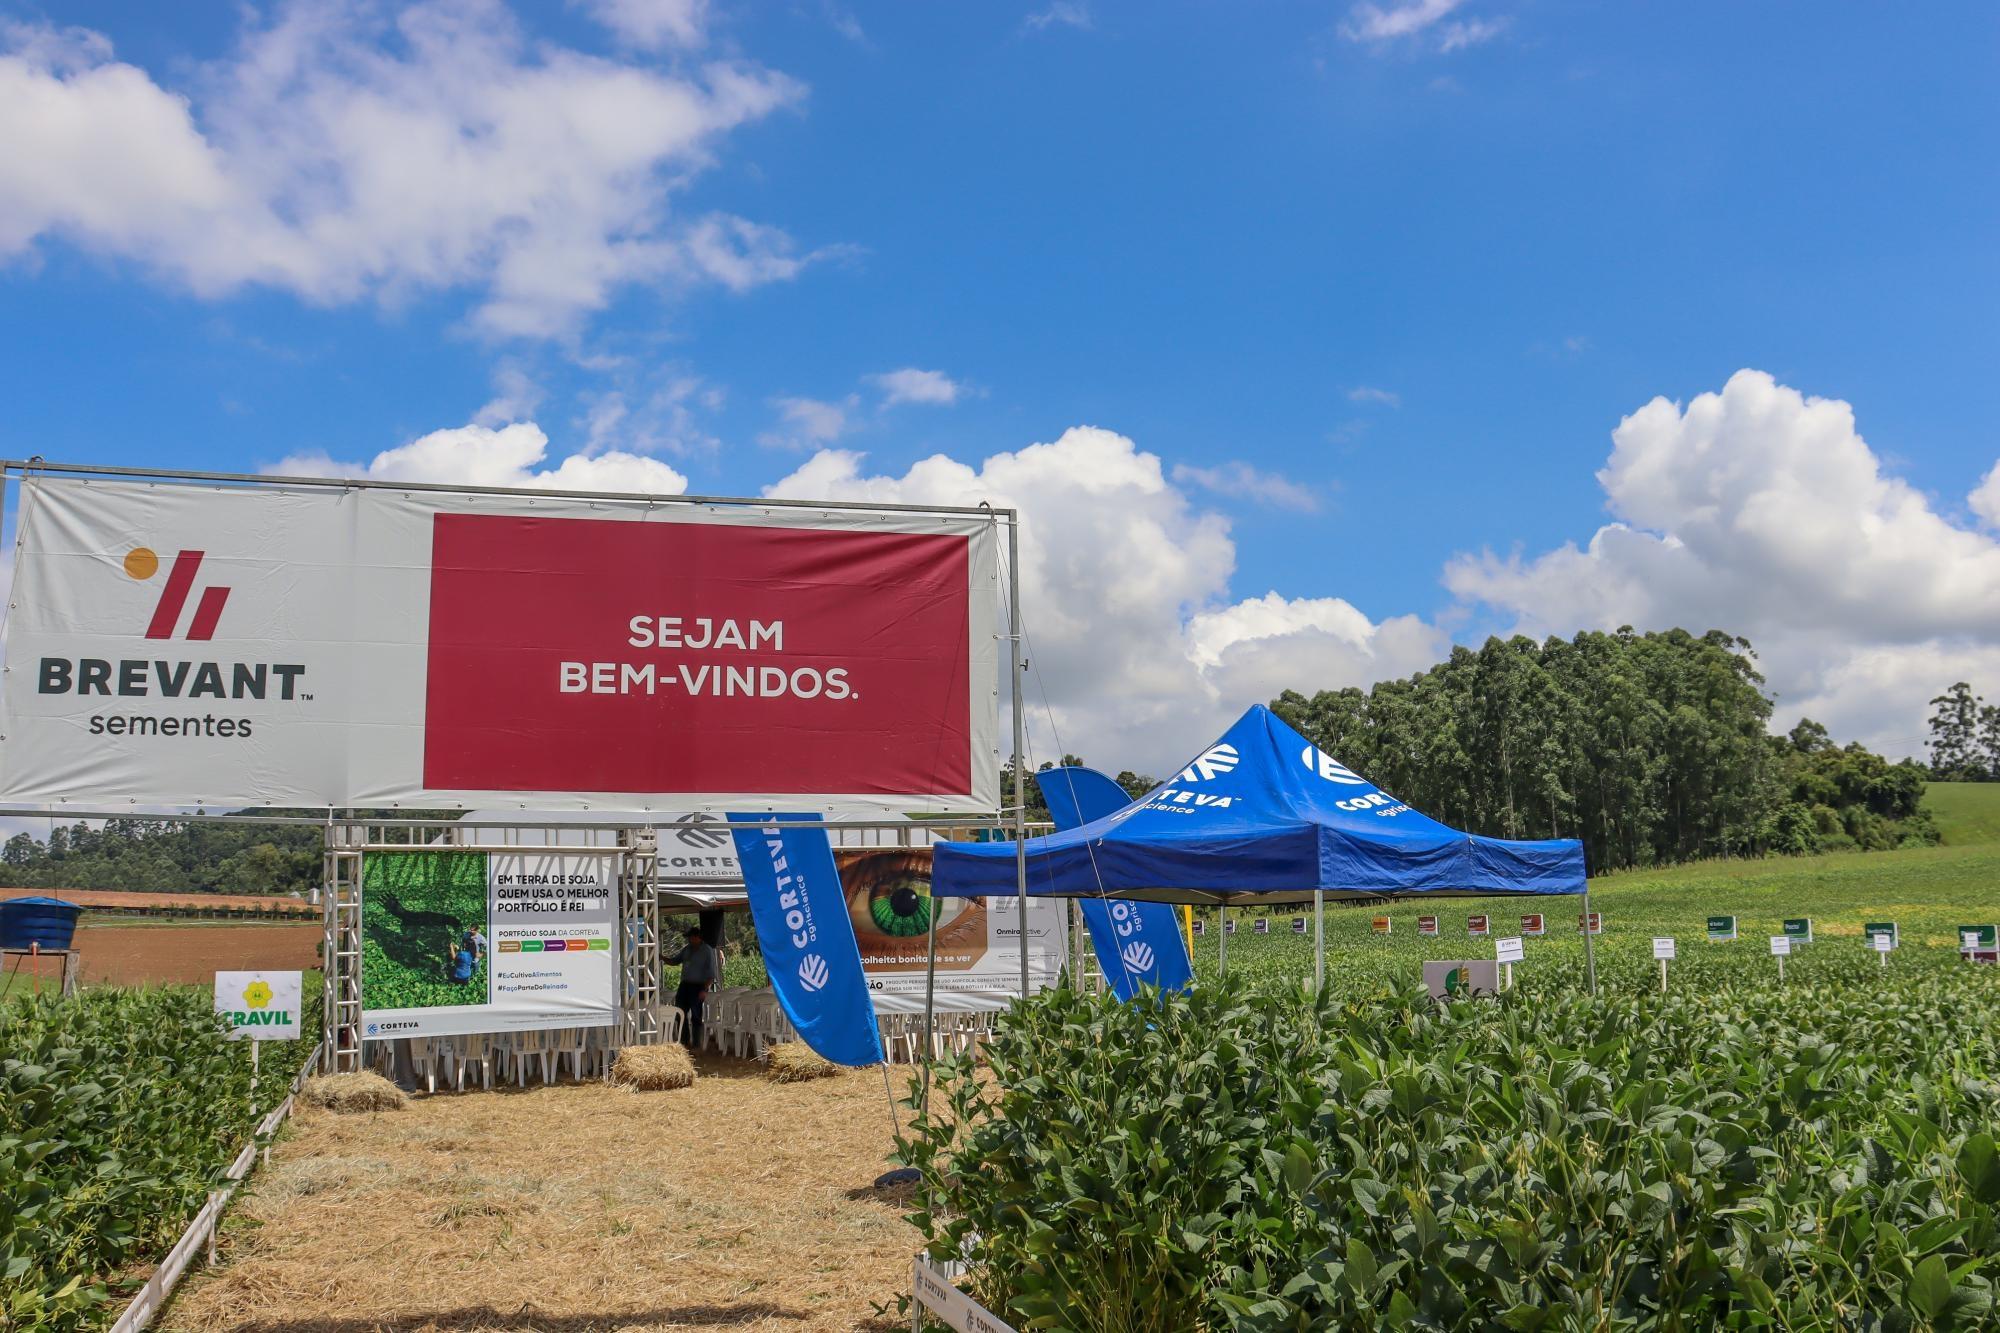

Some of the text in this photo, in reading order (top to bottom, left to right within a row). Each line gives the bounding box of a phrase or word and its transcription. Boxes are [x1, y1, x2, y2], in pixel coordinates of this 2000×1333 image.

[628, 615, 783, 651] SEJAM
[38, 657, 305, 700] BREVANT
[559, 661, 859, 700] BEM-VINDOS.
[89, 713, 252, 738] sementes
[657, 856, 739, 868] CORTE
[497, 875, 598, 887] EM TERRA DE SOJA,
[497, 888, 609, 899] QUEM USA O MELHOR
[497, 900, 585, 912] PORTFÓLIO É REI
[796, 874, 817, 942] agriscience
[1109, 899, 1132, 937] CO
[498, 929, 537, 937] PORTFÓLIO
[898, 955, 928, 963] bonita
[380, 1021, 419, 1030] CORTEVA
